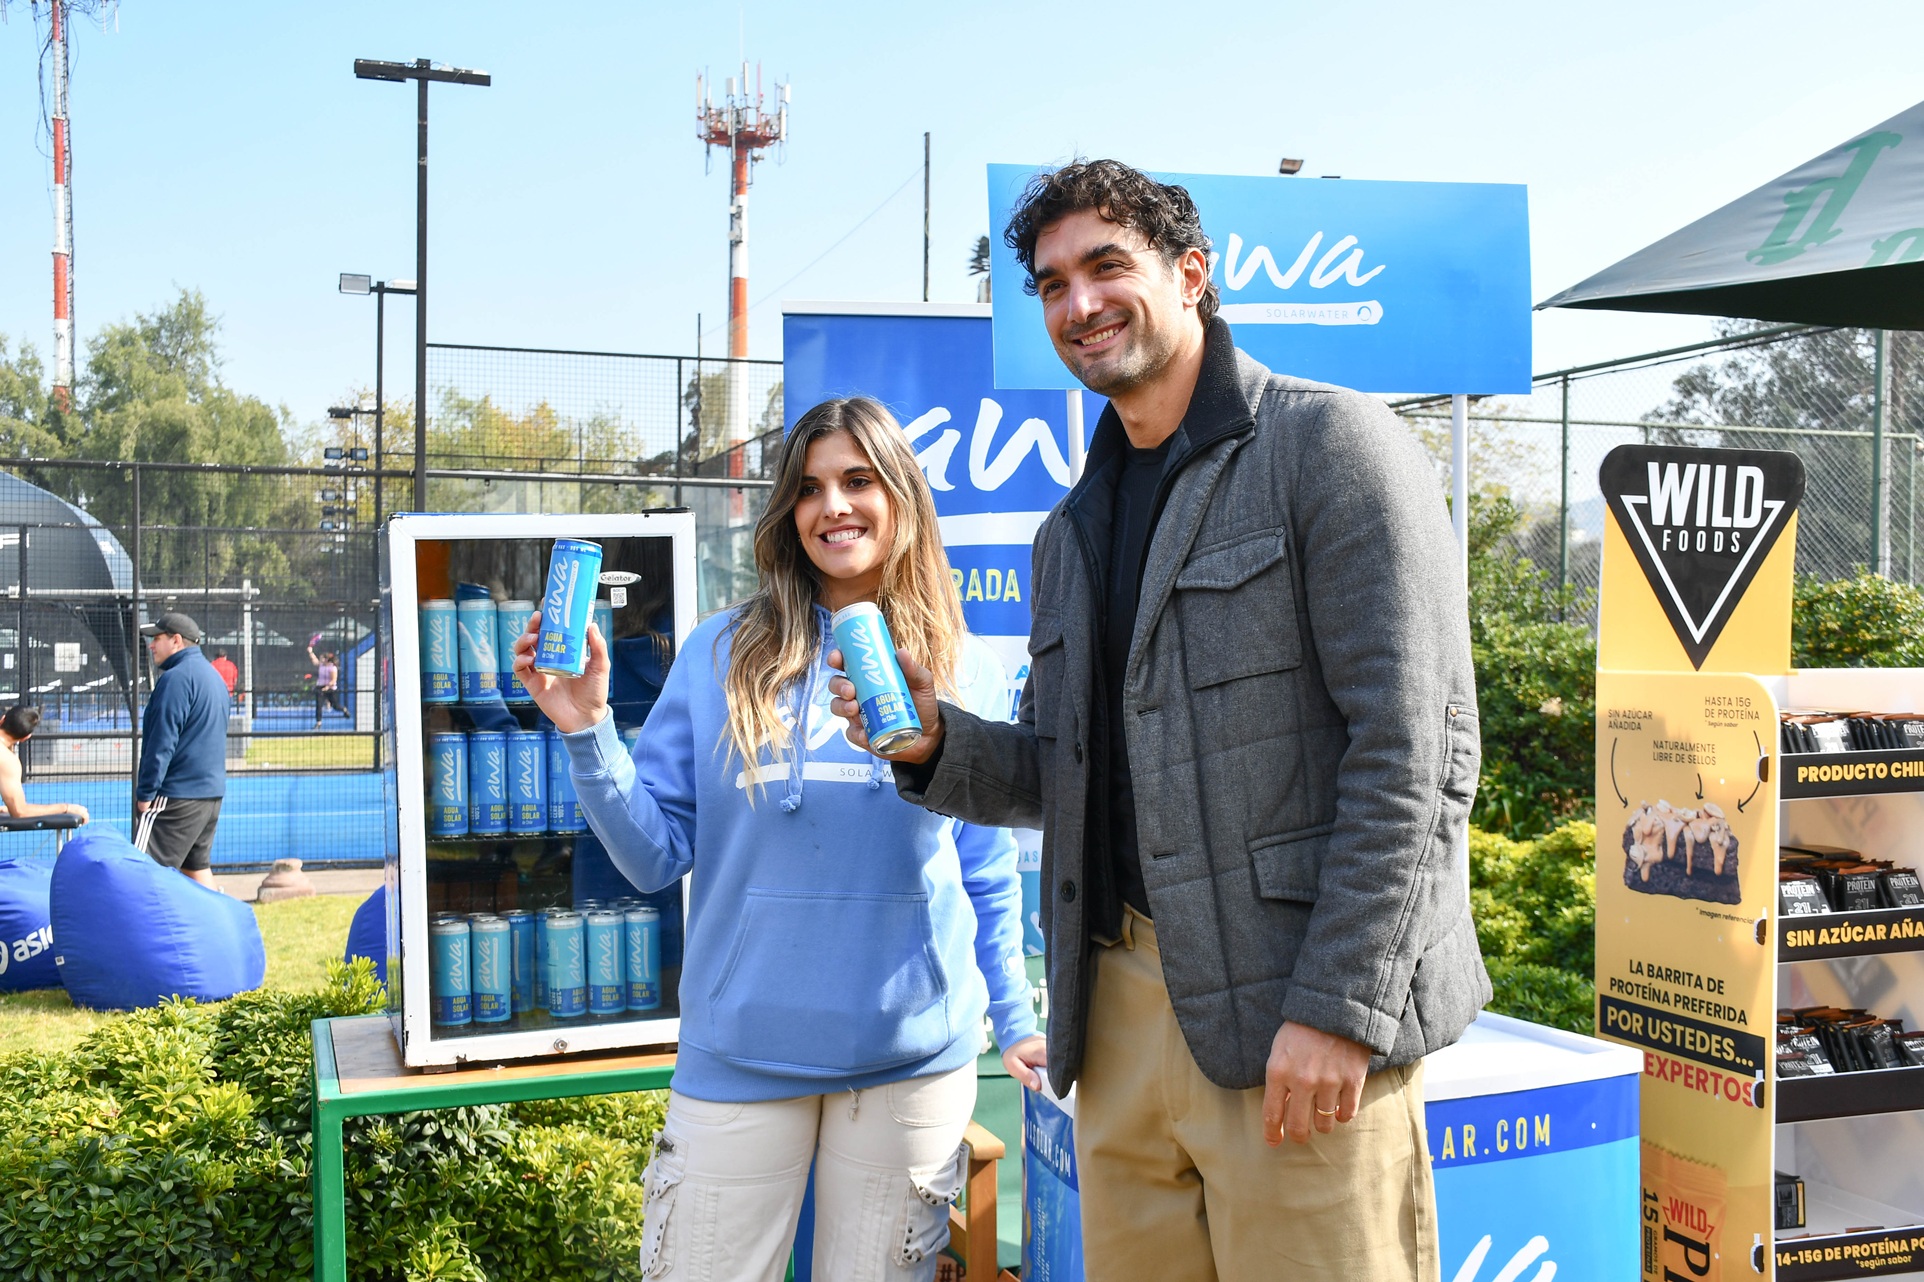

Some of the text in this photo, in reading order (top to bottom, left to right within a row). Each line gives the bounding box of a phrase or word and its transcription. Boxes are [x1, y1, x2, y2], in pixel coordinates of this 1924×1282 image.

[1209, 231, 1386, 291] wa
[1266, 308, 1349, 319] SOLARWATER
[1647, 462, 1765, 529] WILD
[1663, 530, 1741, 553] FOODS
[548, 557, 568, 625] awa
[430, 615, 443, 667] awa
[543, 642, 566, 653] SOLAR
[545, 632, 563, 642] AGUA
[850, 621, 885, 686] awa
[876, 693, 896, 706] AGUA
[878, 703, 905, 716] SOLAR
[1705, 696, 1751, 708] HASTA 15G
[887, 714, 897, 723] Chile
[1608, 708, 1653, 720] SIN AZÚCAR
[1608, 719, 1642, 731] AÑADIDA
[1705, 708, 1760, 720] DE PROTEÍNA
[1653, 740, 1716, 754] NATURALMENTE
[1653, 752, 1716, 766] LIBRE DE SELLOS
[441, 747, 454, 801] awa
[487, 746, 500, 799] awa
[519, 746, 532, 799] awa
[840, 767, 893, 778] SOLAW
[1797, 761, 1924, 783] PRODUCTO CHIL
[1781, 884, 1815, 896] PROTEIN
[1847, 880, 1876, 891] PROTEIN
[1890, 877, 1919, 887] PROTEIN
[1786, 917, 1924, 948] SIN AZÚCAR AÑA
[449, 938, 462, 991] awa
[479, 936, 490, 989] awa
[599, 929, 612, 981] awa
[630, 926, 642, 978] awa
[1629, 959, 1724, 995] LA BARRITA DE
[481, 1002, 498, 1010] SOLAR
[1610, 977, 1748, 1026] PROTEÍNA PREFERIDA
[1607, 1006, 1754, 1067] POR USTEDES...
[1644, 1052, 1755, 1107] EXPERTOS
[1643, 1187, 1658, 1223] 15
[1669, 1196, 1707, 1233] WILD
[1776, 1249, 1823, 1267] 14-15G
[1824, 1247, 1842, 1261] DE
[1844, 1237, 1909, 1258] PROTEÍNA
[1887, 1255, 1912, 1265] sabor
